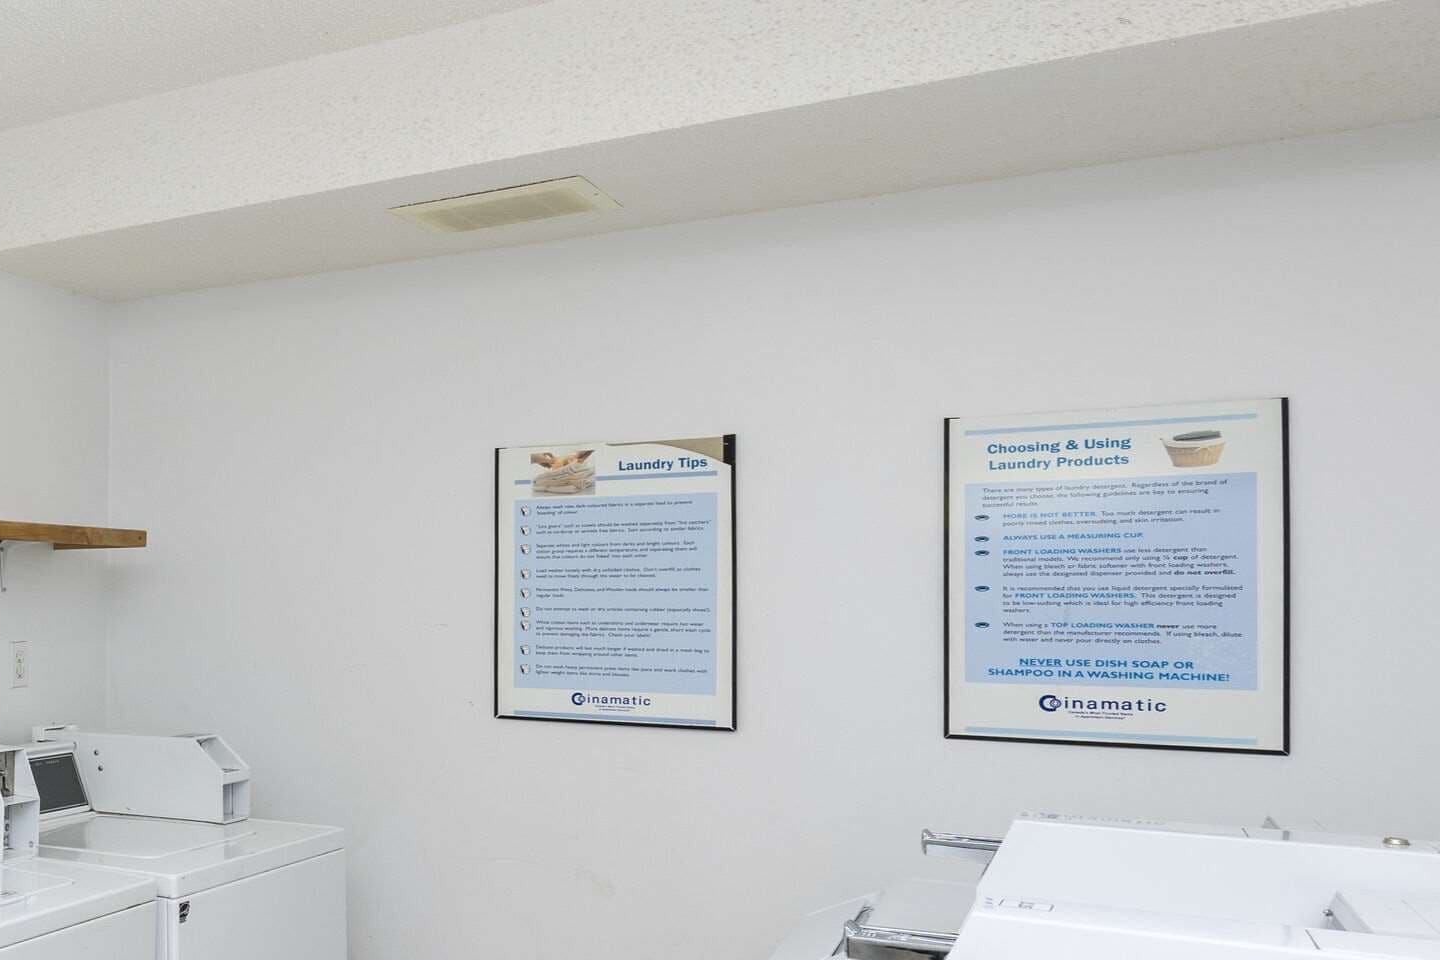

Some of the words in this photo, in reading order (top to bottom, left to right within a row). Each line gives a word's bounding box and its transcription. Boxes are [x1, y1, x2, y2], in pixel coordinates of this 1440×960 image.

[987, 441, 1060, 454] Choosing
[1066, 439, 1078, 450] &
[1084, 438, 1131, 449] Using
[618, 459, 673, 472] Laundry
[678, 457, 708, 470] Tips
[989, 458, 1051, 470] Laundry
[1057, 455, 1129, 467] Products
[1019, 658, 1062, 667] NEVER
[1065, 658, 1091, 667] USE
[1096, 659, 1127, 668] DISH
[1132, 660, 1168, 669] SOAP
[1173, 661, 1194, 670] OR
[988, 668, 1054, 678] SHAMPOO
[1058, 669, 1072, 678] IN
[1074, 669, 1084, 678] A
[1086, 670, 1154, 680] WASHING
[1159, 672, 1230, 682] MACHINE!
[571, 692, 651, 706] Coinamatic
[1039, 694, 1167, 713] Coinamatic
